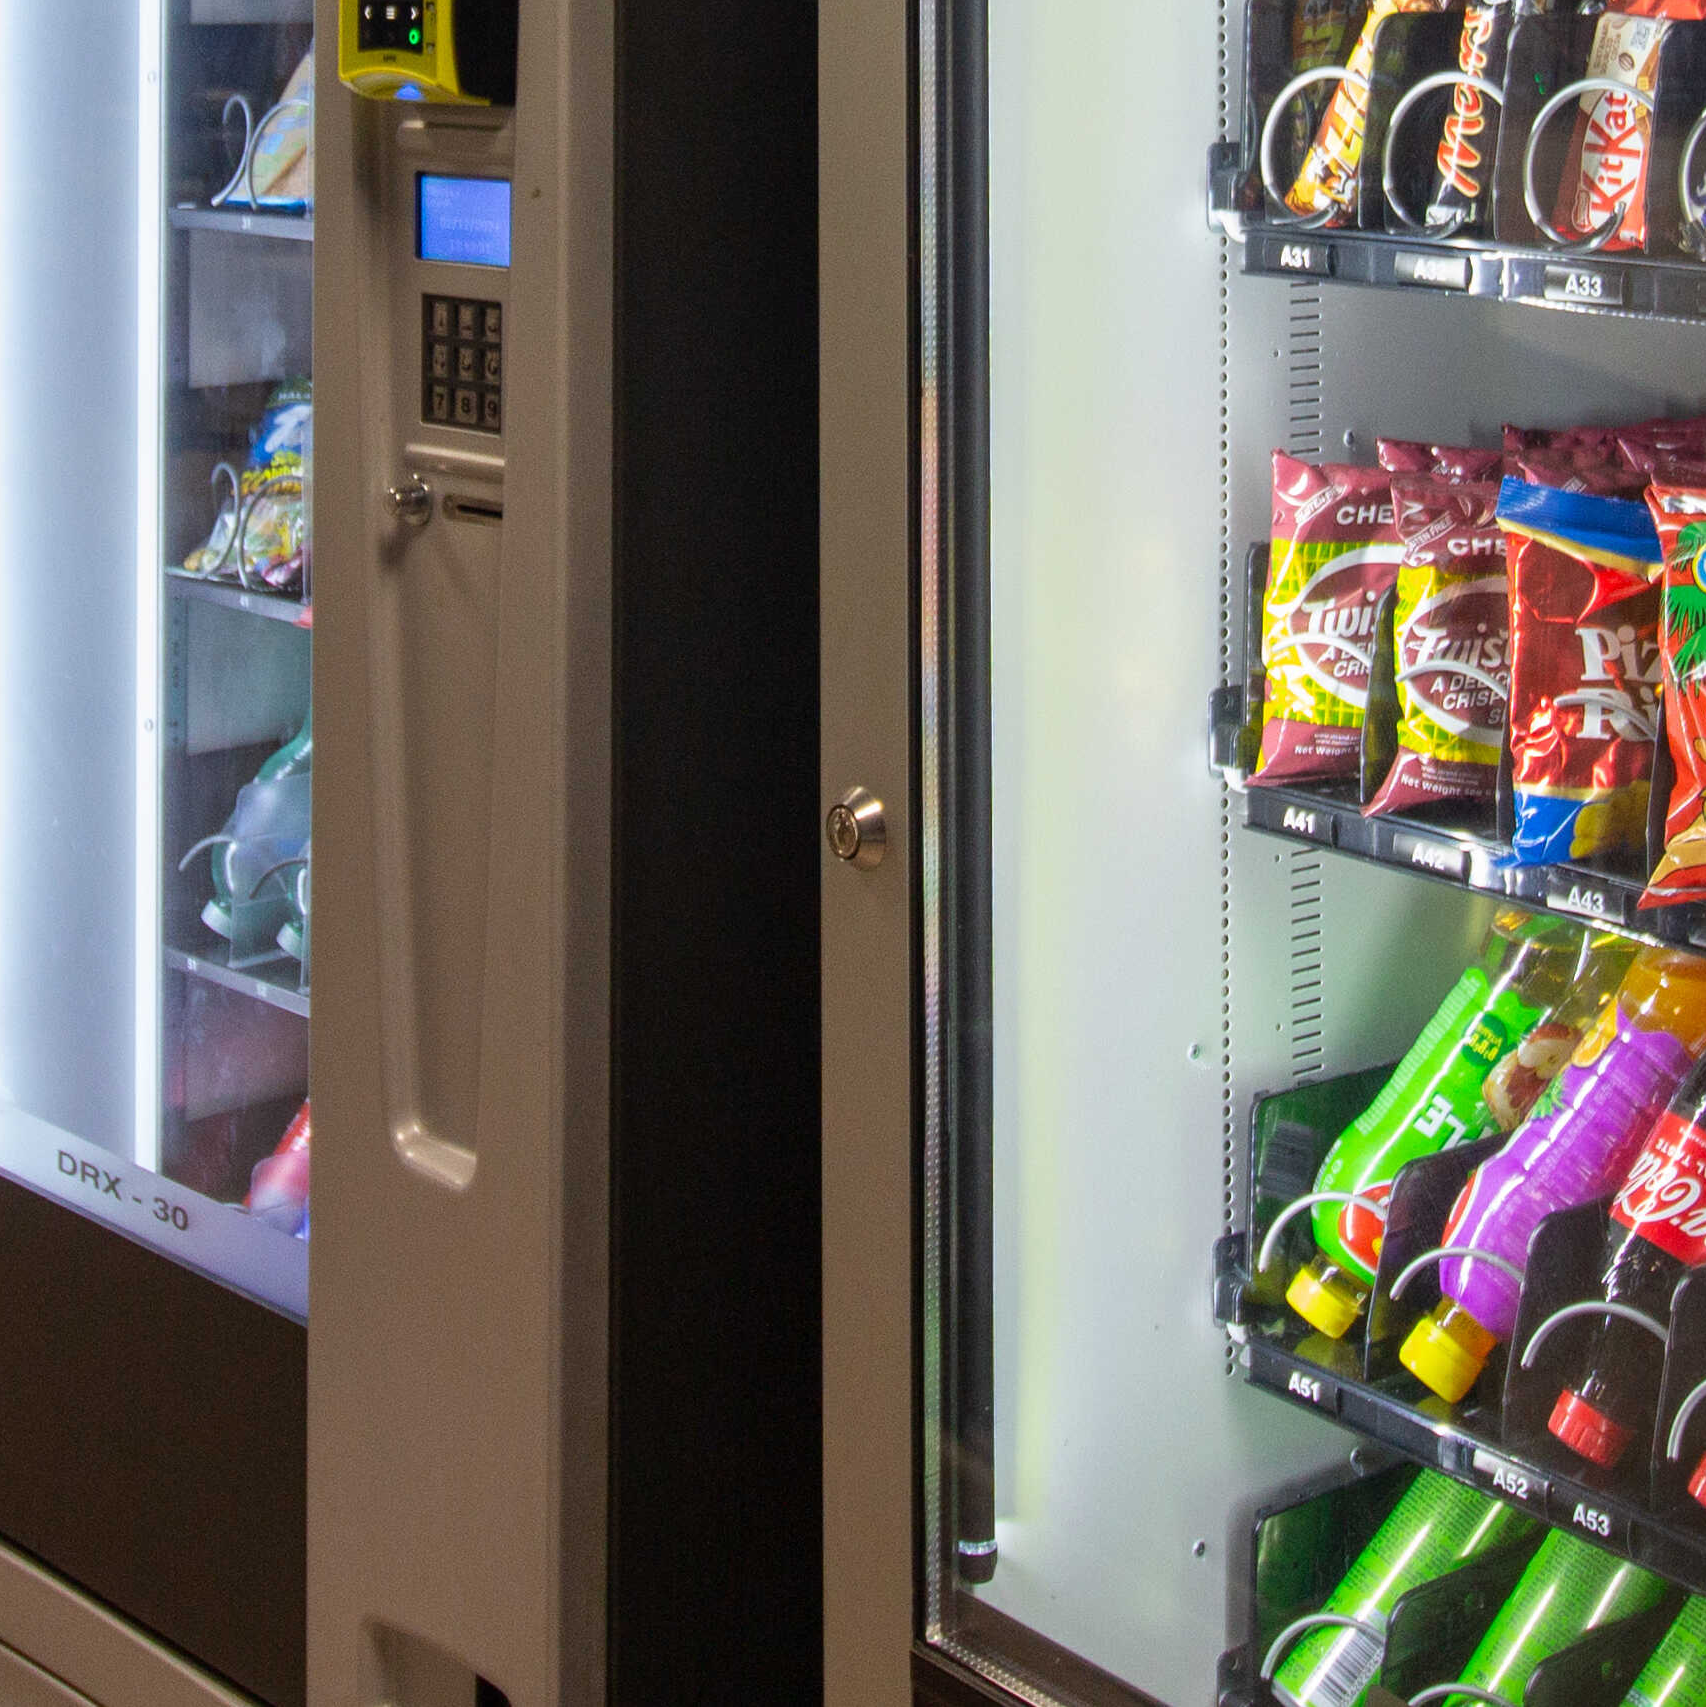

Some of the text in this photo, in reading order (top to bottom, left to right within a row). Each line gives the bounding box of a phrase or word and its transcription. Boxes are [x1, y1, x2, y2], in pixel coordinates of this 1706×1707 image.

[1437, 5, 1493, 198] Mars
[1589, 90, 1643, 229] KitKat
[1280, 246, 1311, 268] A31
[1565, 274, 1603, 297] A33
[460, 396, 471, 414] 8
[1336, 503, 1393, 525] CHE
[1446, 536, 1507, 557] CHE
[1301, 590, 1376, 639] Twi
[1575, 624, 1661, 683] Piz
[1430, 676, 1444, 694] A
[1442, 692, 1507, 711] CRISP
[1575, 687, 1659, 742] Ri
[1283, 811, 1316, 834] A41
[1411, 849, 1445, 872] A42
[1567, 890, 1605, 914] A43
[57, 1150, 122, 1202] DRX
[153, 1198, 189, 1233] 30
[1288, 1373, 1321, 1401] A51
[1493, 1470, 1529, 1500] A52
[1573, 1505, 1611, 1537] A53
